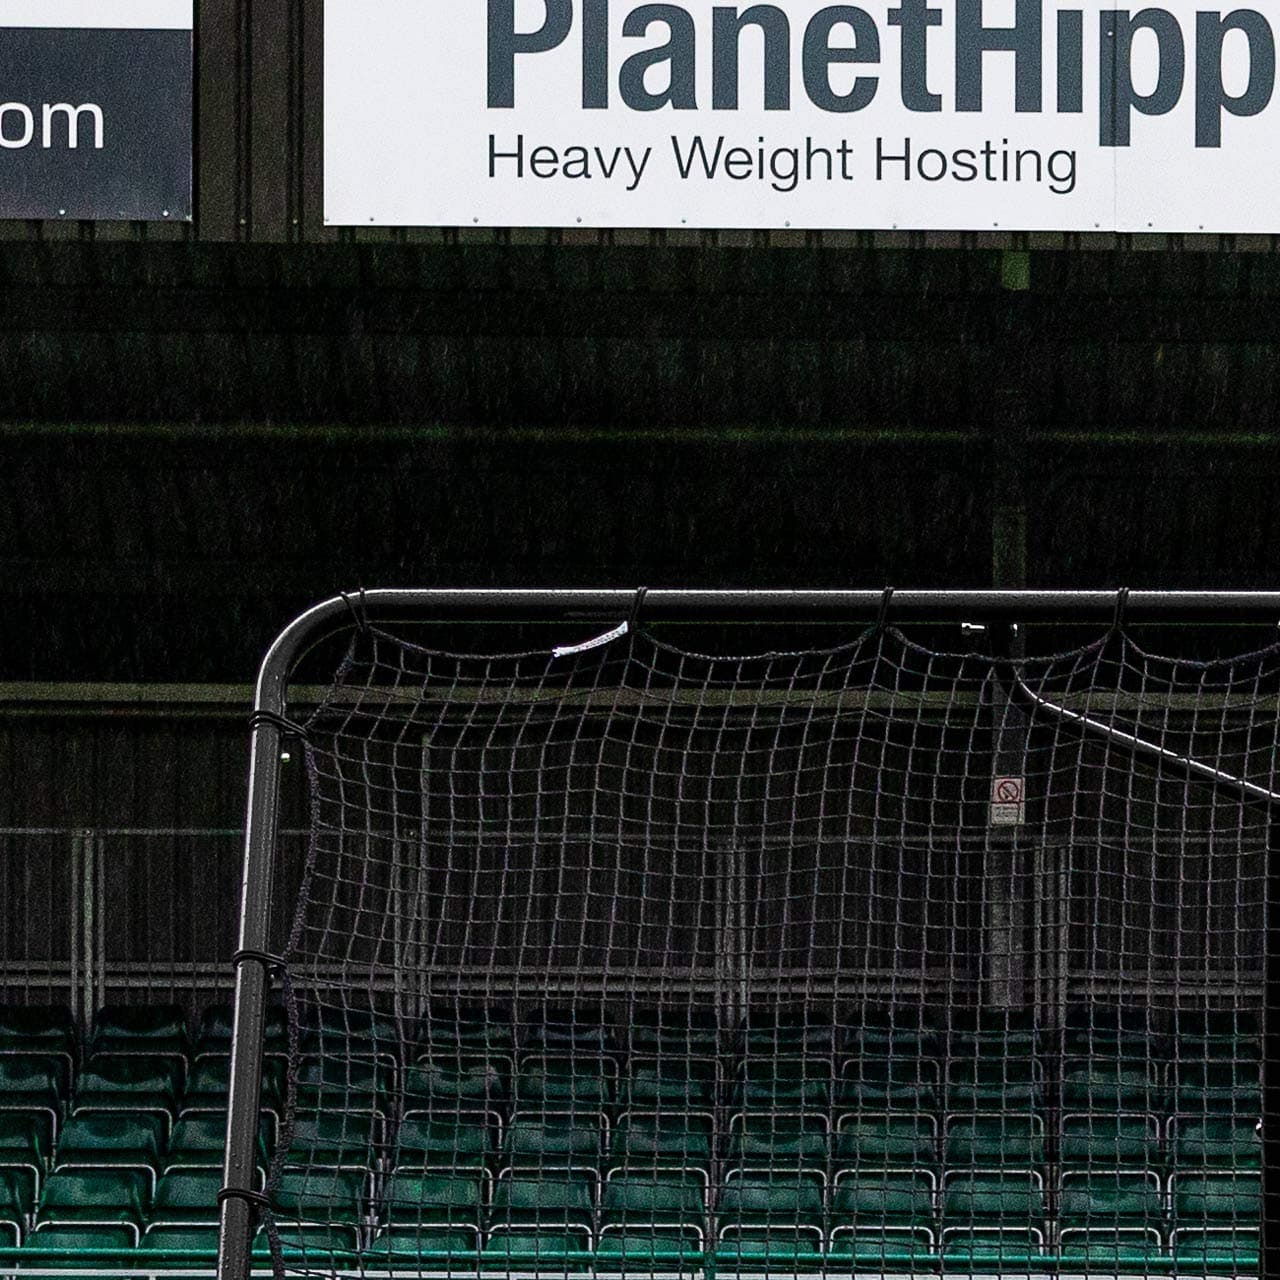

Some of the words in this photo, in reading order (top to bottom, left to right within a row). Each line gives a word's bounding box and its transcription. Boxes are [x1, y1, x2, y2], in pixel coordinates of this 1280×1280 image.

[0, 102, 104, 149] om
[488, 134, 651, 191] Heavy
[673, 136, 853, 191] Weight
[875, 138, 1077, 193] Hosting
